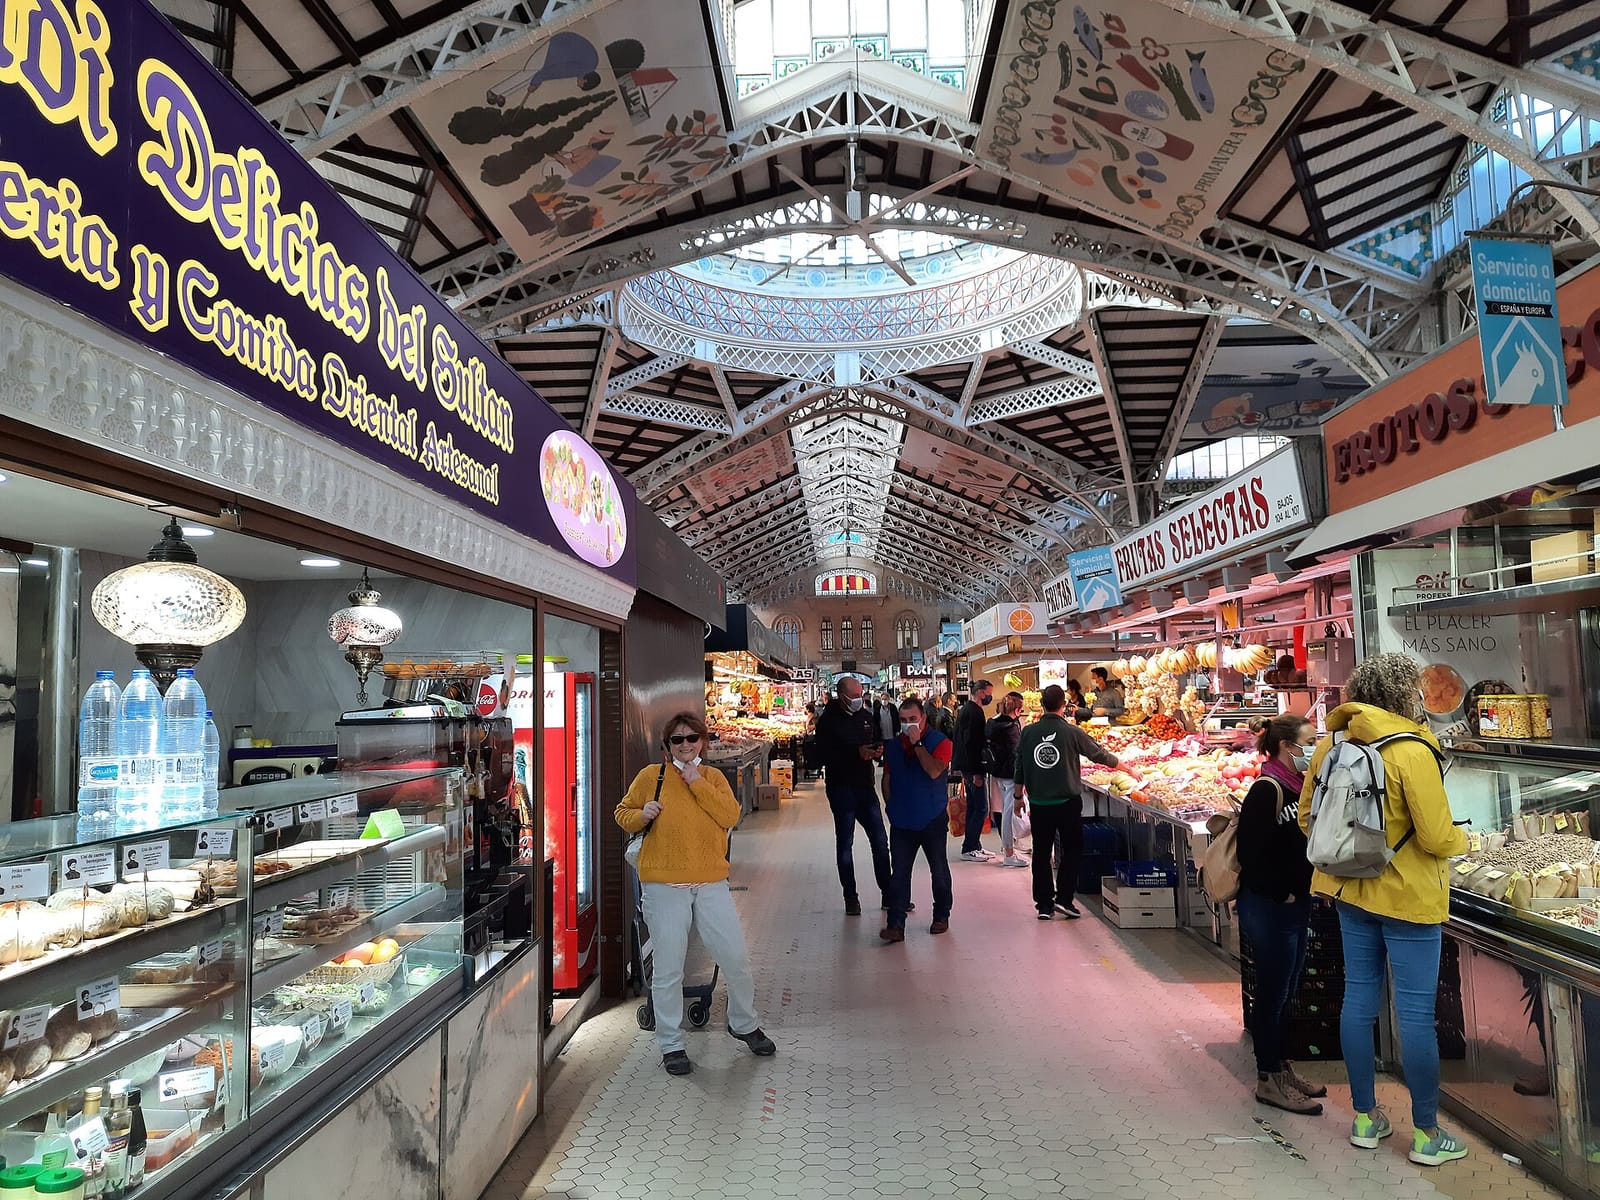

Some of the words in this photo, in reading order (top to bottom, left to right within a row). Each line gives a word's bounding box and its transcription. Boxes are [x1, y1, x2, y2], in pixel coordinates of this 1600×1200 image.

[1193, 131, 1248, 193] PRIMAVERA
[137, 58, 370, 343] Delicias
[376, 266, 427, 392] del
[432, 324, 514, 454] Sultan
[1477, 252, 1538, 278] Servicio
[1541, 264, 1550, 279] a
[1482, 279, 1551, 303] domicilio
[1500, 303, 1520, 314] ESPAÑA
[1525, 306, 1546, 315] EUROPA
[129, 244, 169, 332] y
[177, 259, 318, 402] Comida
[419, 421, 499, 505] Artesanal
[1333, 377, 1478, 483] FRUTOS
[1276, 494, 1293, 509] BAJOS
[1114, 530, 1166, 583] FRUTAS
[1168, 475, 1270, 564] SELECTAS
[1072, 554, 1103, 567] Servicio
[1074, 562, 1111, 575] domicilio
[1044, 577, 1073, 614] FRUTAS
[1405, 614, 1421, 631] EL
[1427, 614, 1492, 630] PLACER
[1402, 635, 1441, 653] MÁS
[1446, 635, 1497, 653] SANO
